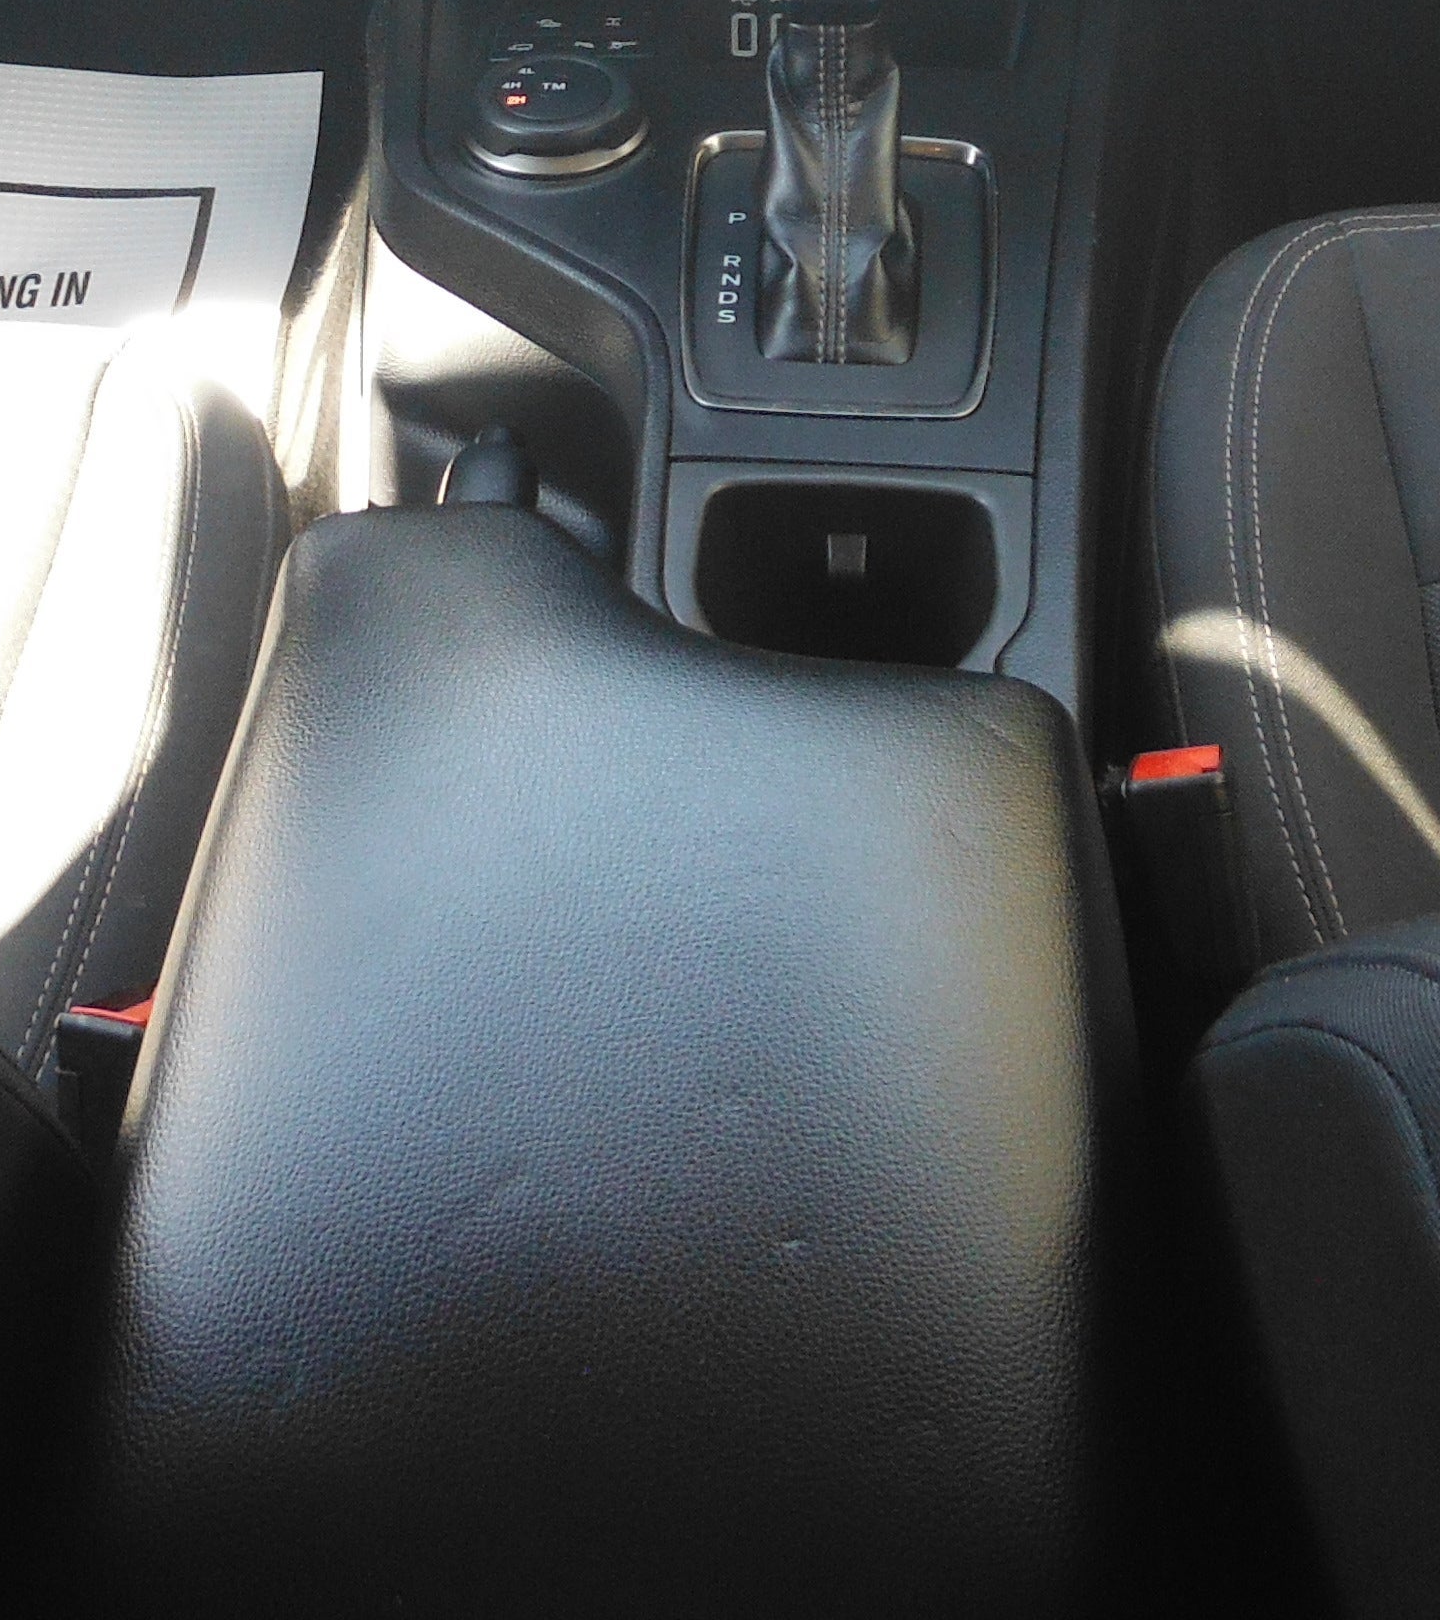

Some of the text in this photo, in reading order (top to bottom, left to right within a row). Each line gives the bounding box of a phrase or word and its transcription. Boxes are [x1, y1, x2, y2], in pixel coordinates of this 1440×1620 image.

[518, 67, 536, 75] 4L
[501, 81, 567, 91] 4H TM
[728, 212, 747, 225] P
[722, 254, 742, 268] R
[721, 273, 741, 287] N
[50, 270, 92, 308] IN
[718, 291, 739, 305] D
[717, 309, 737, 324] S
